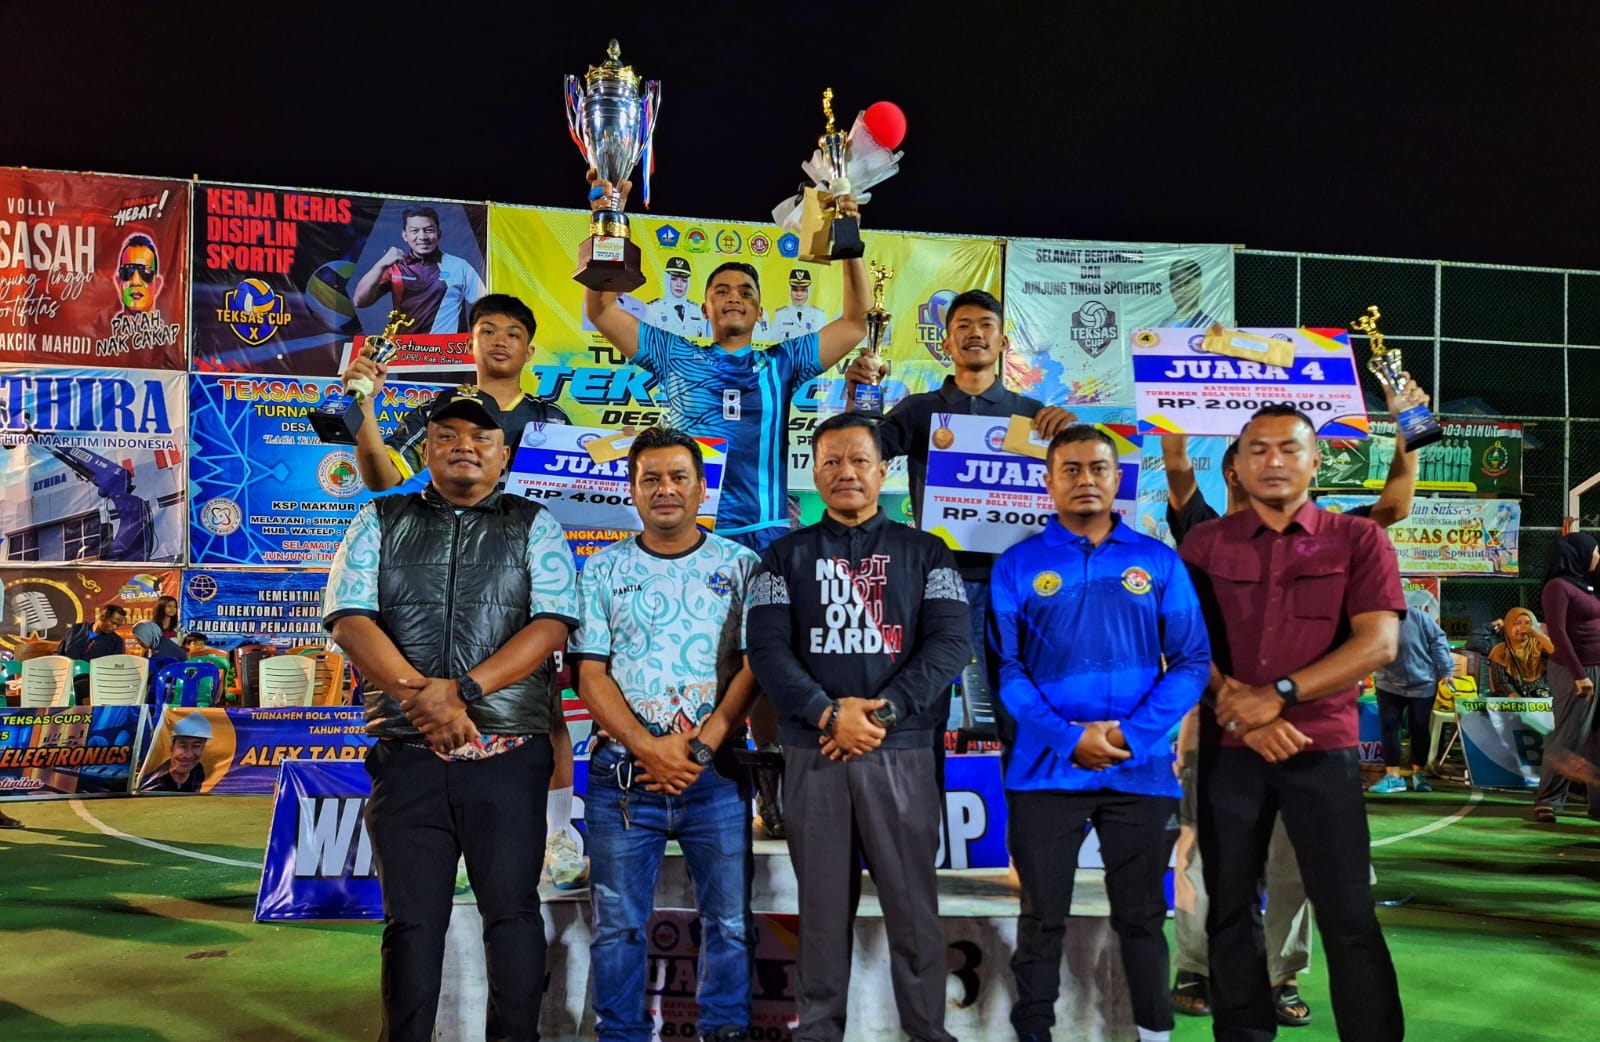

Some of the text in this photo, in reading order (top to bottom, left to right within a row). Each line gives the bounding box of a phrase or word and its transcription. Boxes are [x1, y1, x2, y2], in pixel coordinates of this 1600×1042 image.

[8, 198, 55, 216] VOLLY
[110, 190, 169, 226] HEBAT!
[207, 189, 352, 224] KERJA KERAS
[207, 216, 297, 247] DISIPLIN
[207, 245, 295, 274] SPORTIF
[1036, 249, 1143, 263] SELAMAT BERTANDING
[1081, 265, 1101, 279] DAN
[1022, 281, 1162, 295] JUNJUNG TINGGI SPORTIFITAS
[111, 311, 161, 336] PAYAH
[216, 309, 291, 325] TEKSAS CUP
[95, 324, 180, 356] NAK CAKAP
[249, 327, 259, 340] X
[918, 326, 948, 341] TEK
[1072, 327, 1117, 339] TEKSAS
[1091, 347, 1098, 355] X
[1164, 360, 1325, 380] JUARA 4
[219, 380, 319, 403] TEKSAS
[532, 365, 660, 407] TEK
[0, 376, 173, 434] THIRA
[722, 389, 741, 421] 8
[1158, 398, 1201, 409] RP.
[601, 410, 660, 426] DES
[281, 422, 315, 433] DESA
[40, 435, 99, 448] MARITIM
[103, 437, 175, 450] INDONESIA
[544, 455, 629, 477] JUAR
[956, 459, 1048, 488] JUAR
[517, 479, 568, 488] TURNAMEN
[524, 488, 634, 506] RP. 4.000
[933, 496, 982, 505] TURNAMEN
[985, 499, 1008, 507] BOLA
[988, 492, 1033, 500] KATEGORI
[272, 501, 297, 511] KSP
[301, 503, 356, 511] MAKMUR
[250, 516, 304, 524] MELAYANI
[313, 517, 351, 525] SIMPAN
[942, 507, 1050, 527] RP. 3.000
[263, 527, 289, 535] HUB.
[291, 527, 335, 535] WA/TELP
[1446, 529, 1483, 544] CUP
[1487, 530, 1501, 546] X
[282, 541, 330, 550] SELAMAT
[262, 552, 313, 561] JUNJUNG
[217, 605, 284, 617] DIREKTORAT
[188, 620, 256, 633] PANGKALAN
[2, 714, 94, 725] TEKSAS CUP X
[251, 711, 302, 721] TURNAMEN
[305, 711, 331, 721] BOLA
[334, 711, 357, 721] VOLI
[309, 726, 341, 735] TAHUN
[0, 746, 130, 769] ELECTRONICS
[239, 745, 303, 766] ALEX
[948, 940, 982, 1008] 3
